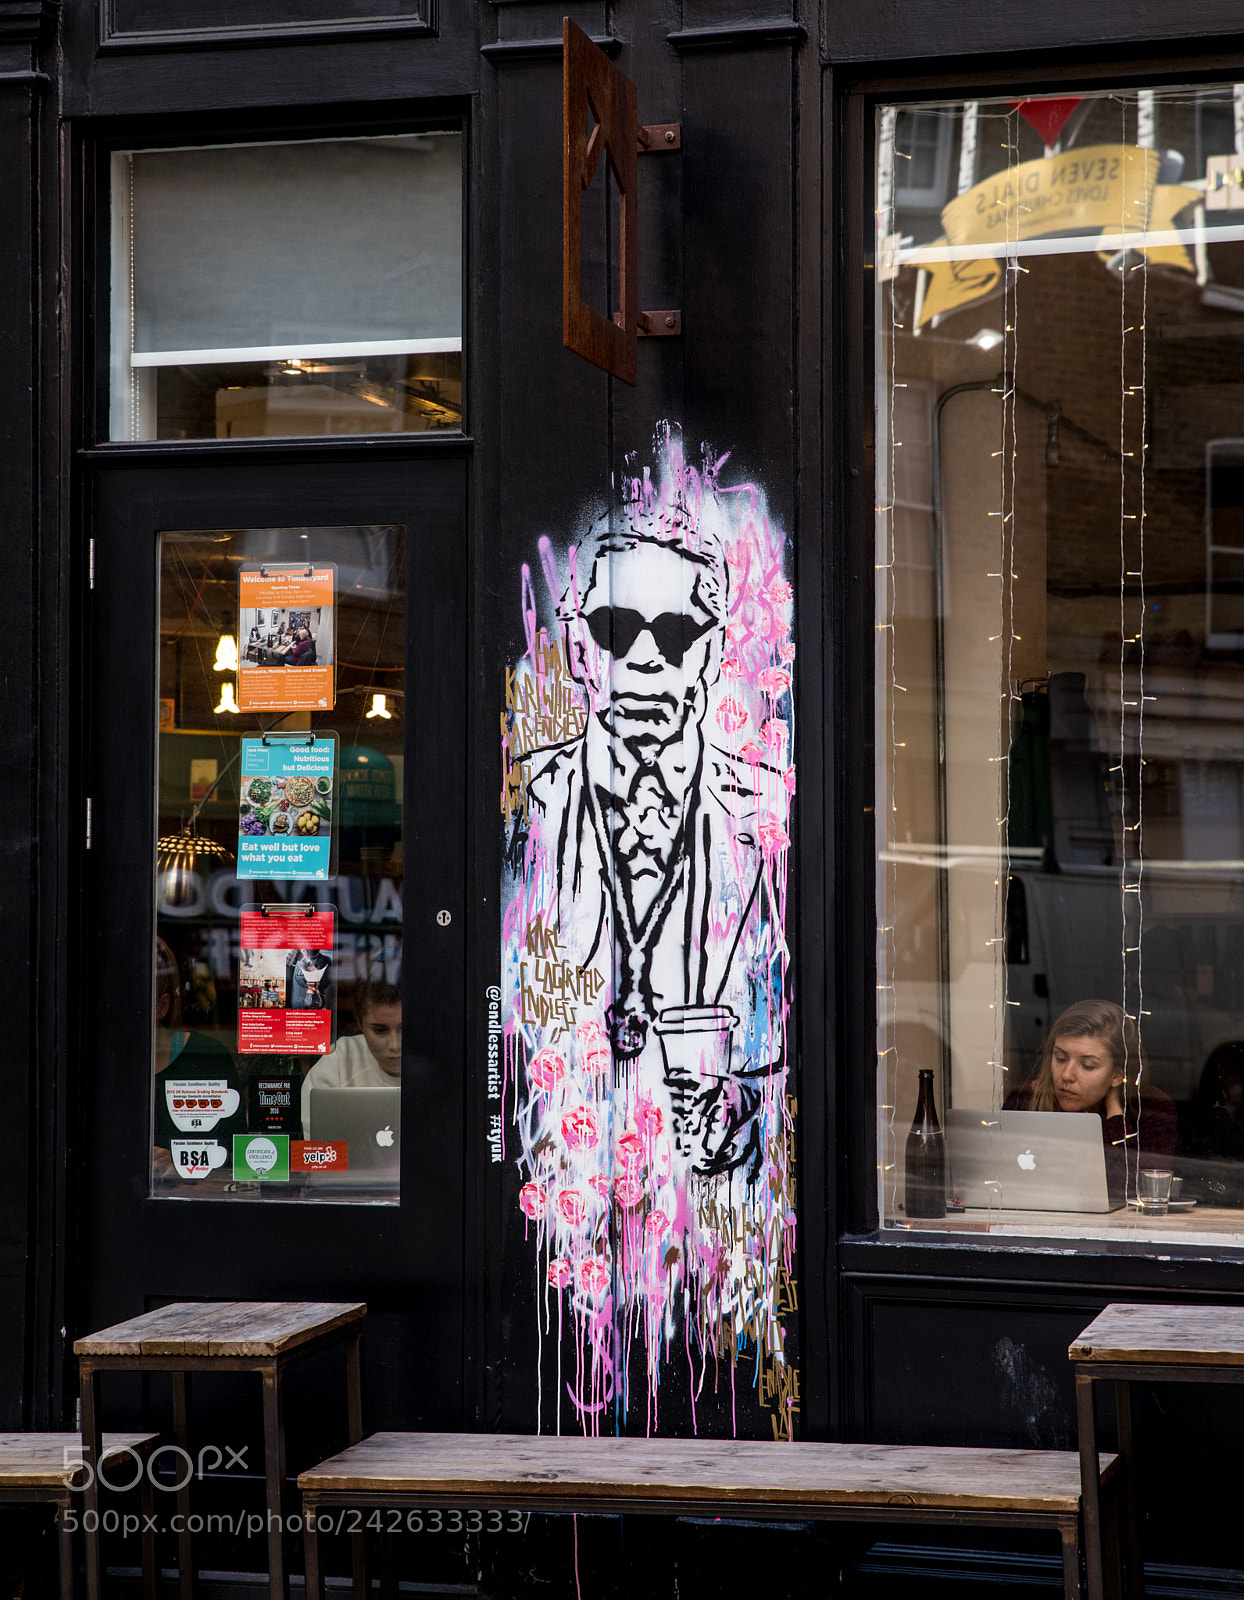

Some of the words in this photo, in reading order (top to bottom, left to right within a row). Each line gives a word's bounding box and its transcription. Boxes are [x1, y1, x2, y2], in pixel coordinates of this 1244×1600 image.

[242, 843, 258, 851] Eat
[260, 843, 279, 851] well
[282, 843, 298, 851] but
[300, 843, 320, 852] love
[241, 853, 265, 862] what
[268, 855, 285, 863] you
[527, 914, 567, 962] KARL
[520, 962, 577, 1032] ENDLESS
[486, 986, 502, 1100] @endlessartist
[180, 1151, 209, 1166] BSA
[303, 1151, 326, 1164] yelp
